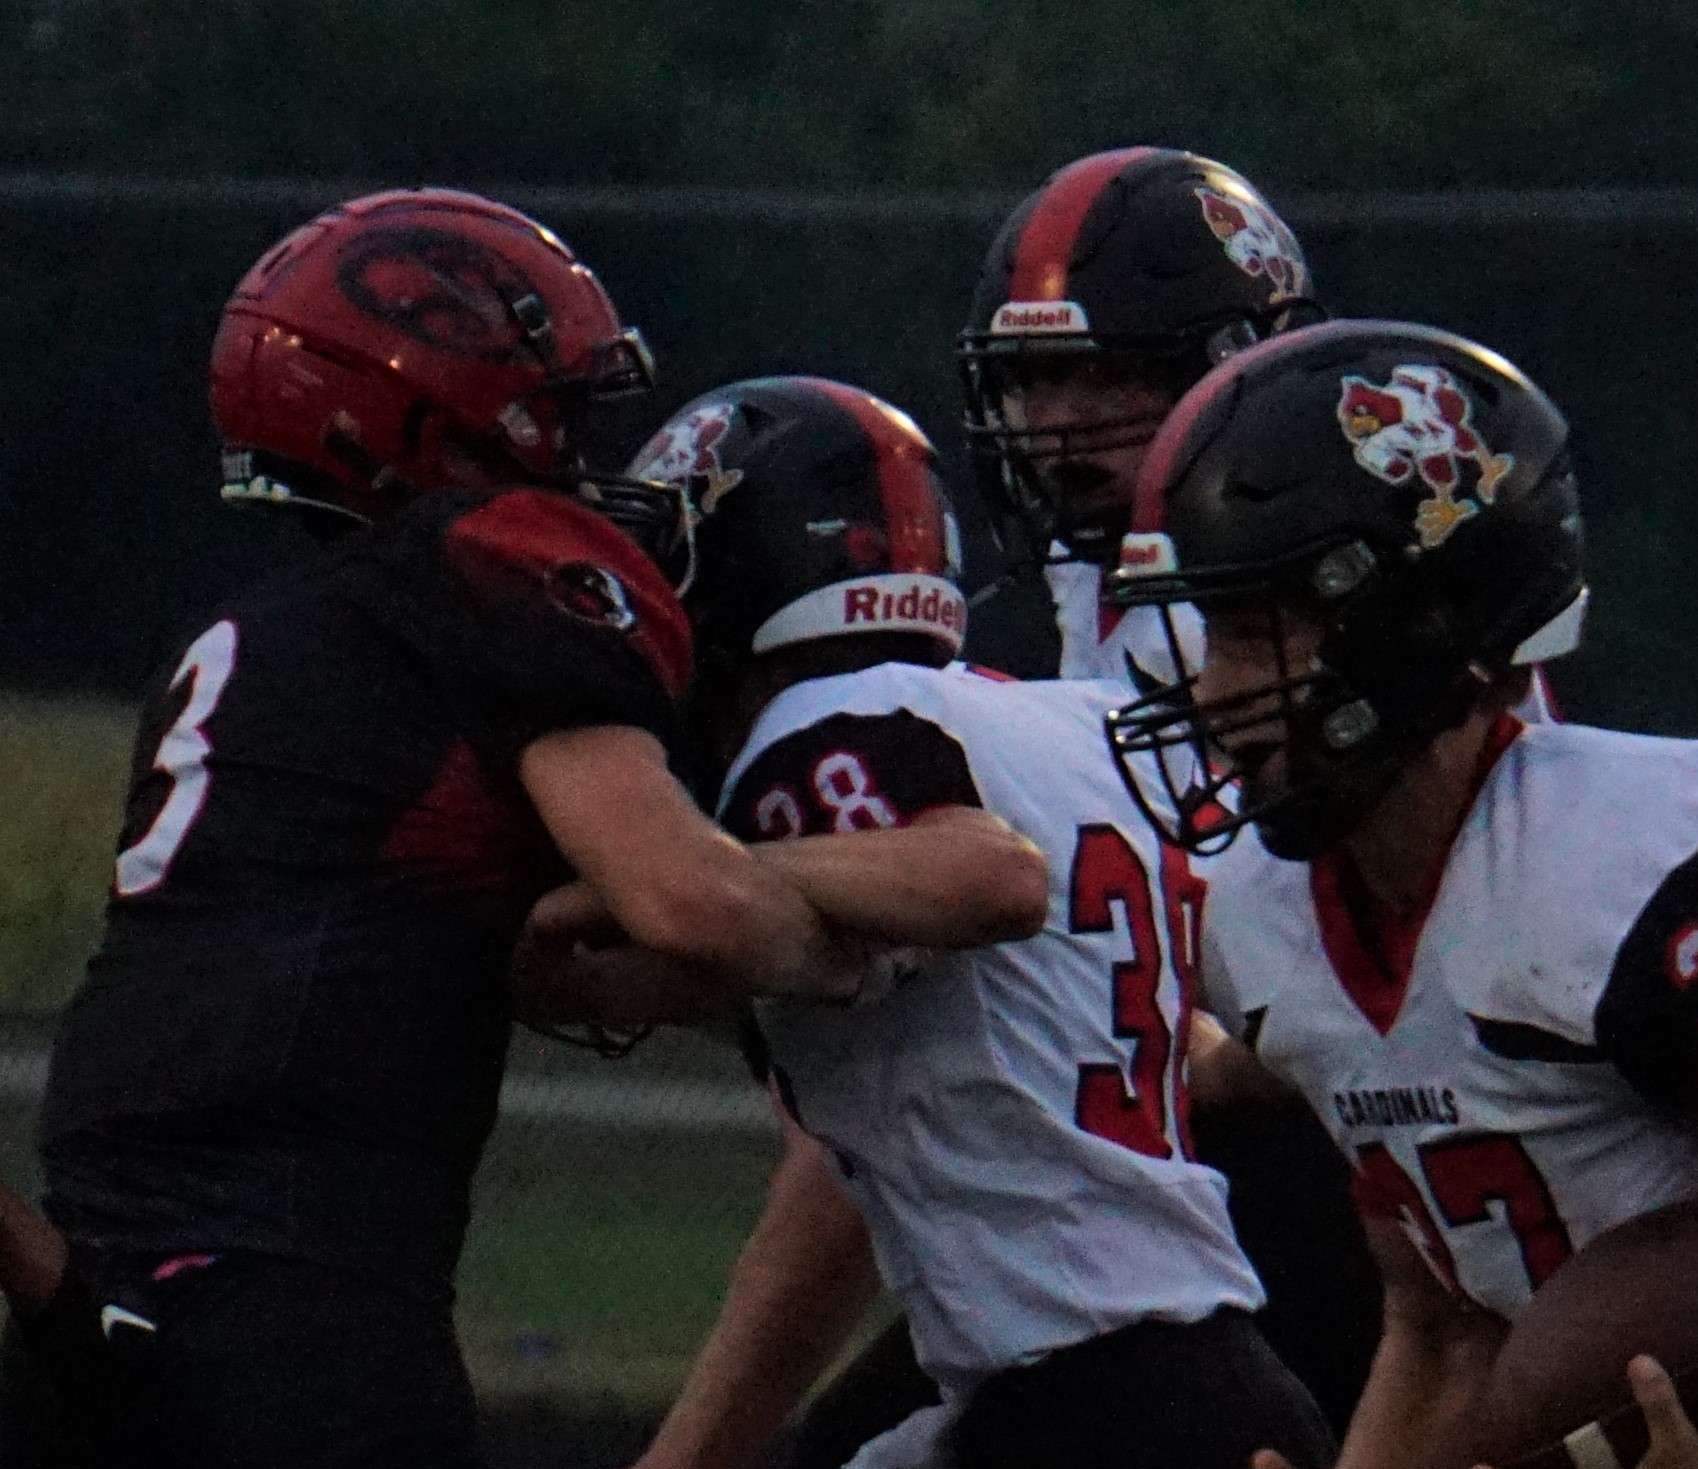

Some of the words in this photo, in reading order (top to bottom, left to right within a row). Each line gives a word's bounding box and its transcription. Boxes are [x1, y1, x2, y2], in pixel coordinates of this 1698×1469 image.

[1001, 308, 1070, 326] Riddell
[115, 618, 238, 896] 3
[1334, 1086, 1459, 1126] CARDINALS
